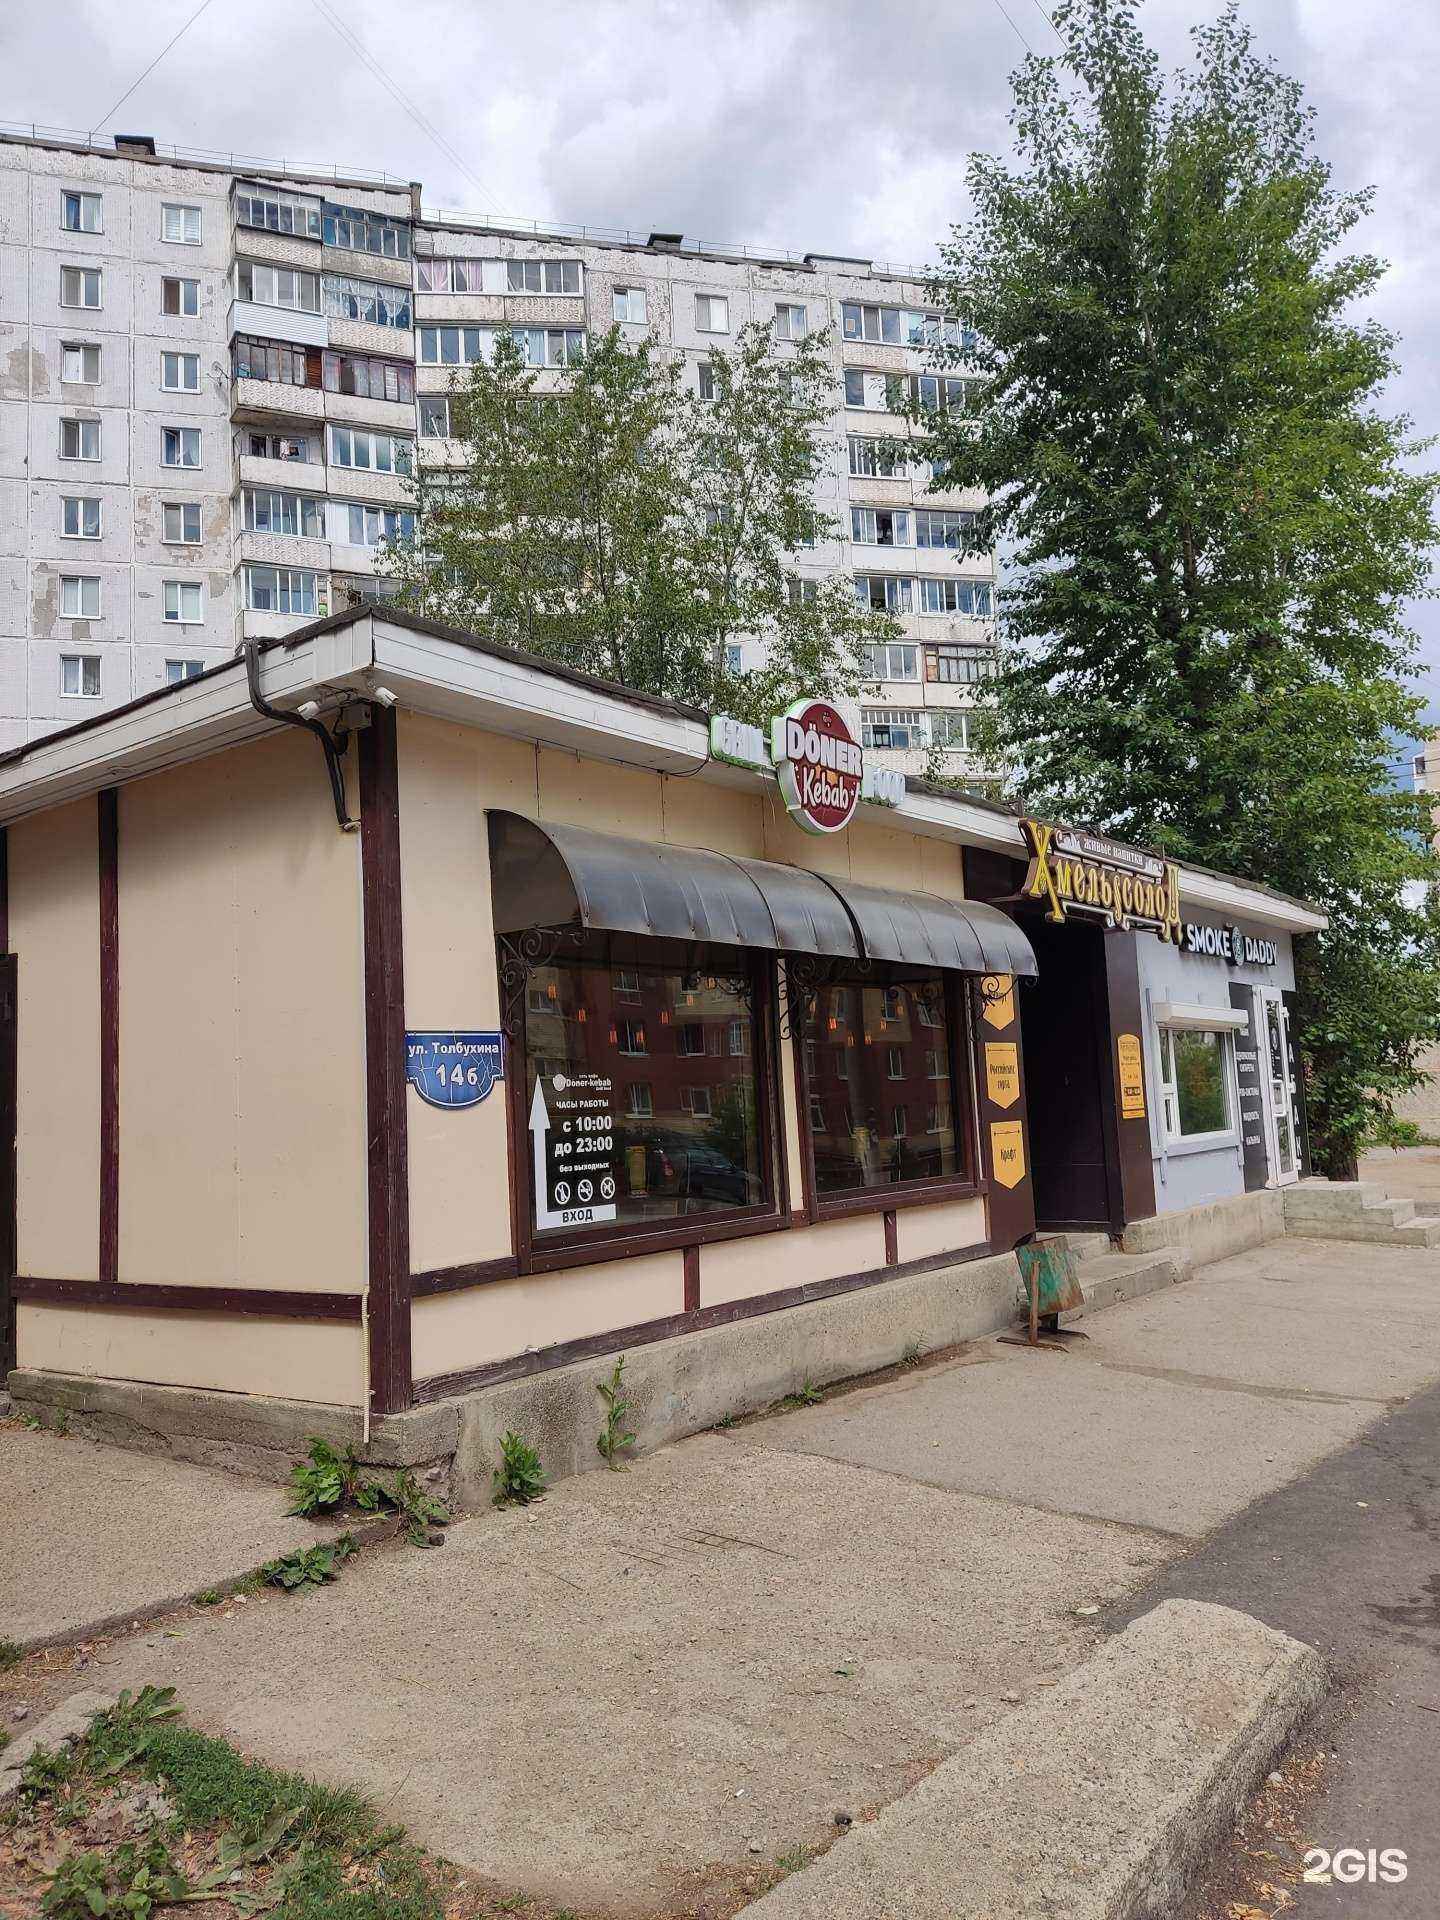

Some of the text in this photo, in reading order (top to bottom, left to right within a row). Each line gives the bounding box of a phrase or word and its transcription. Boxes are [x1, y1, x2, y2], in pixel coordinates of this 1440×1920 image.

[788, 723, 861, 778] DÖNER
[804, 767, 848, 809] Kebab
[1186, 923, 1277, 965] SMOKE DADDY
[408, 1042, 499, 1057] ул. Толбухина
[556, 1099, 609, 1109] ЧАСЫ РАБОТЫ
[563, 1115, 613, 1133] с 10:00
[554, 1136, 613, 1157] до 23:00
[559, 1161, 610, 1172] без выходных
[562, 1209, 594, 1223] ВХОД
